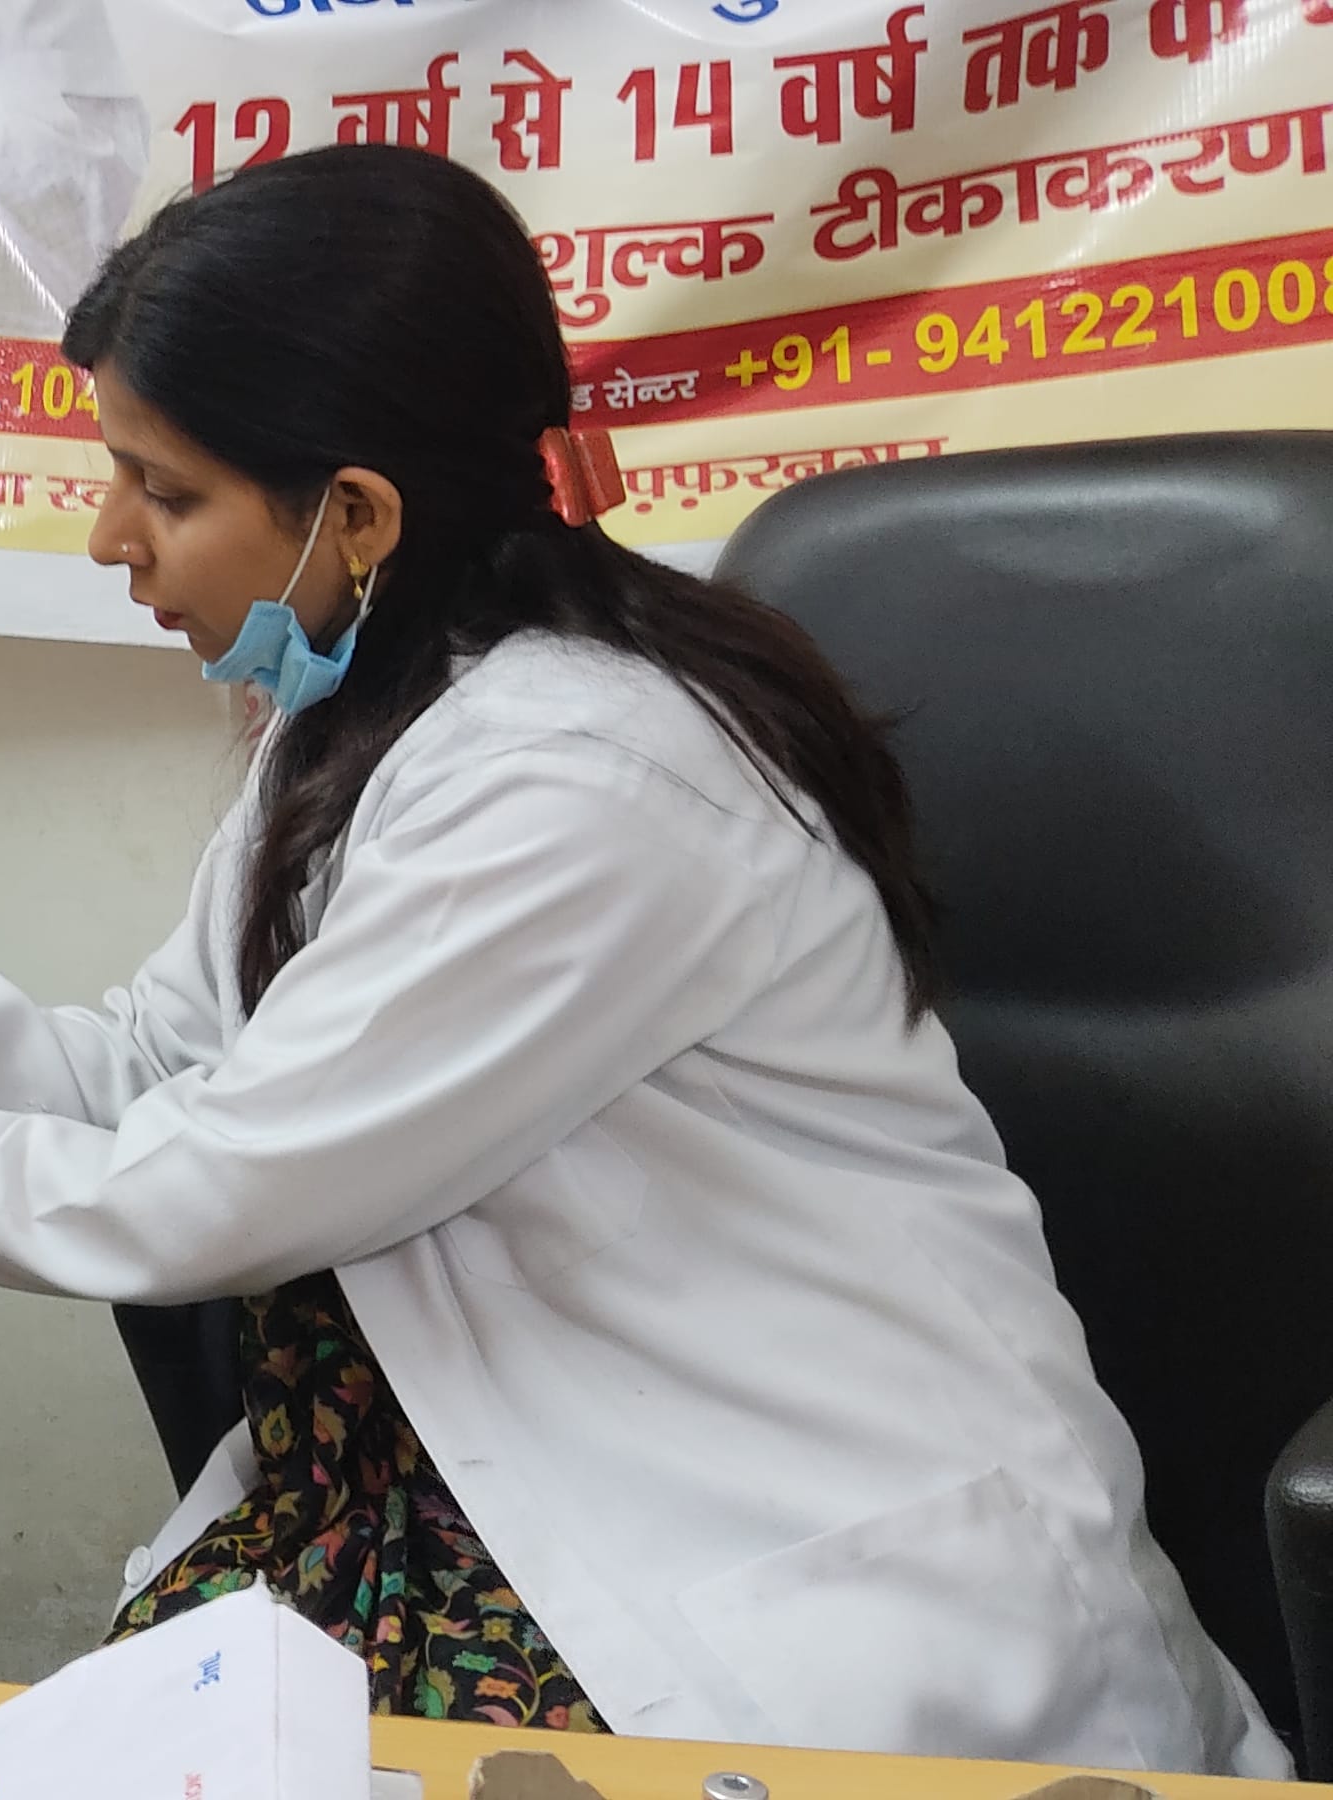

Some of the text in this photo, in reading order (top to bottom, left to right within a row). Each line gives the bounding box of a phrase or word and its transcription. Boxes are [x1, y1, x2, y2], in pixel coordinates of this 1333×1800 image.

[491, 49, 572, 171] से
[617, 60, 733, 162] 14
[773, 4, 928, 145] वर्ष
[961, 0, 1119, 115] तक
[532, 102, 1333, 328] शुल्क टीकाकरण
[602, 367, 700, 410] सेन्टर
[914, 254, 1333, 374] 94122100
